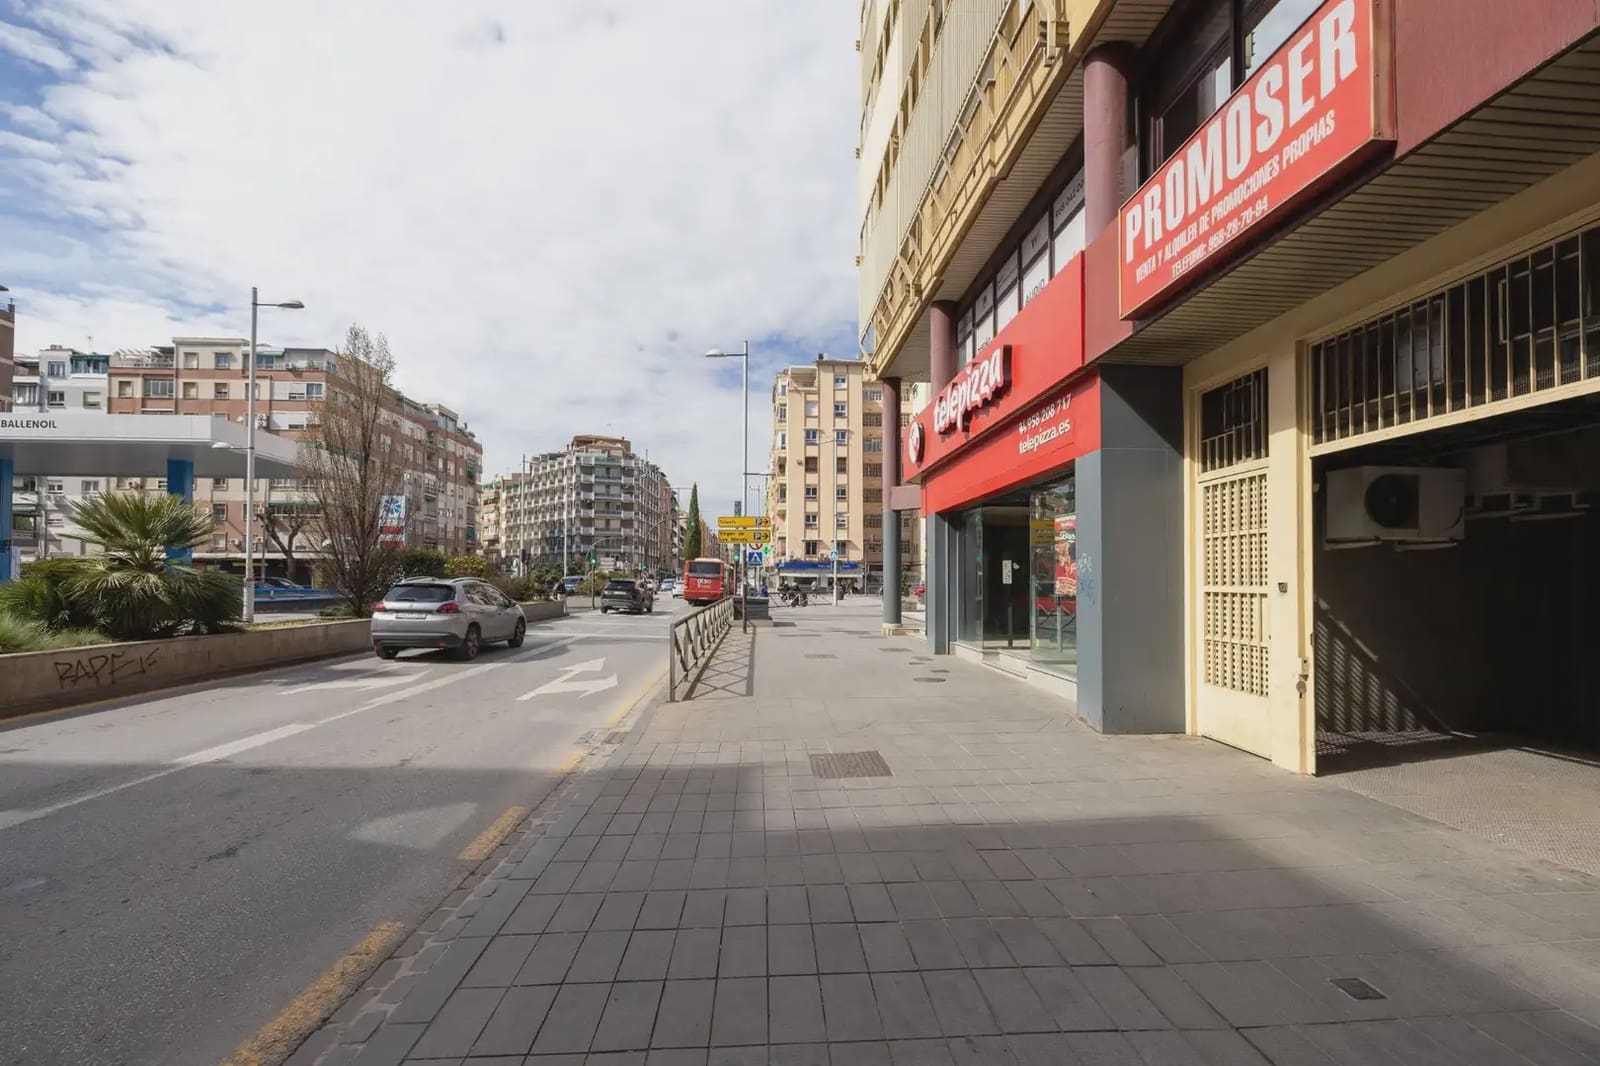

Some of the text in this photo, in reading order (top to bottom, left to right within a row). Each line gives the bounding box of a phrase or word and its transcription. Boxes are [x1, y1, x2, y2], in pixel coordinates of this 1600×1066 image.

[1126, 0, 1358, 264] PROMOSER
[1136, 109, 1335, 284] VENTA Y ALQUILER DE PROMOCIONES PROPIAS
[1, 419, 57, 429] BALLENOIL
[933, 346, 1004, 433] telepizza
[1019, 419, 1071, 454] telepizza.es
